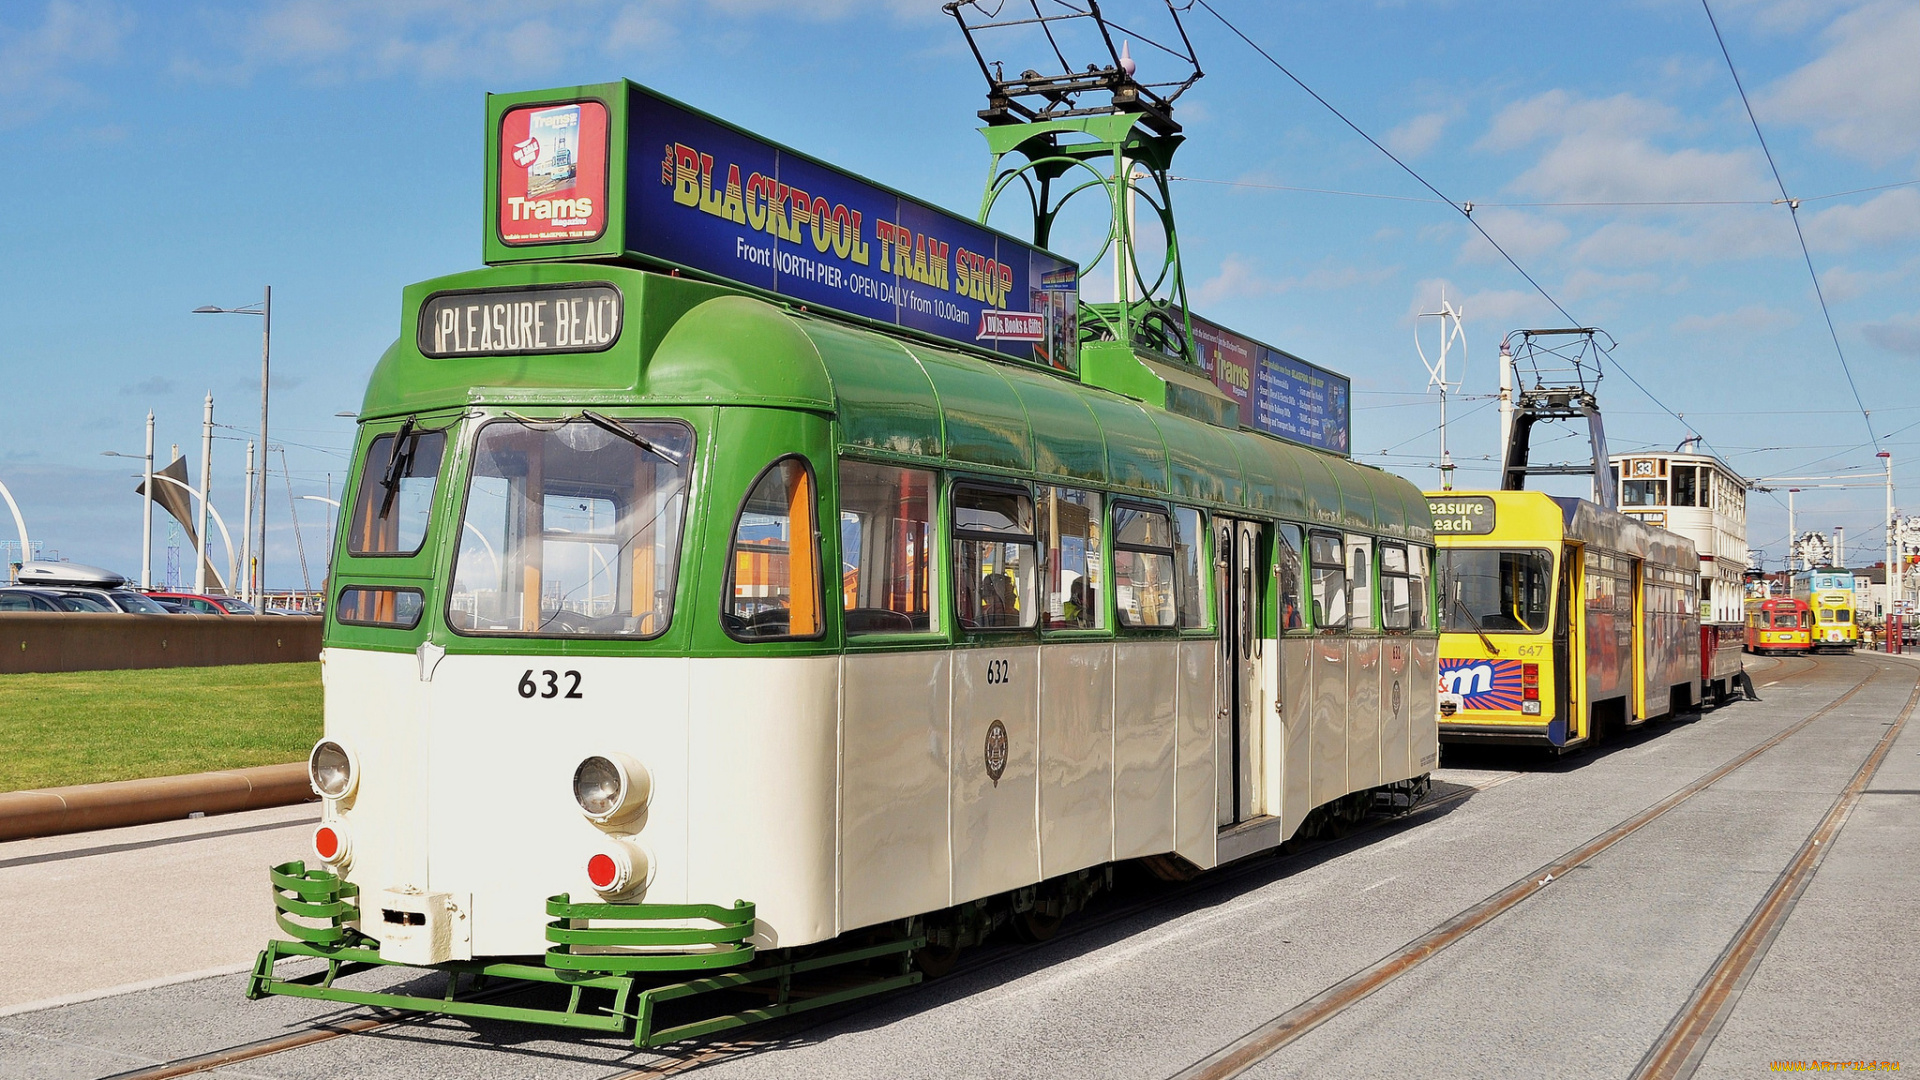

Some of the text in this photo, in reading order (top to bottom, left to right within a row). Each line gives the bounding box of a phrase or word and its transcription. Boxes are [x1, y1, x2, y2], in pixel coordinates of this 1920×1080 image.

[662, 144, 673, 186] The
[507, 196, 593, 221] Trams
[674, 142, 1013, 310] BLACKPOOL TRAM SHOP
[736, 236, 970, 325] Front NORTH PIER OPEN DAILY from 10.00am
[441, 300, 547, 352] PLEASURE
[1005, 317, 1023, 334] Books
[1023, 320, 1028, 334] &
[1028, 318, 1042, 334] Gifts
[1214, 350, 1250, 390] Trams
[1430, 502, 1484, 515] easure
[1433, 515, 1472, 531] each
[1518, 645, 1544, 657] 647
[517, 669, 583, 699] 632
[987, 659, 1009, 685] 632
